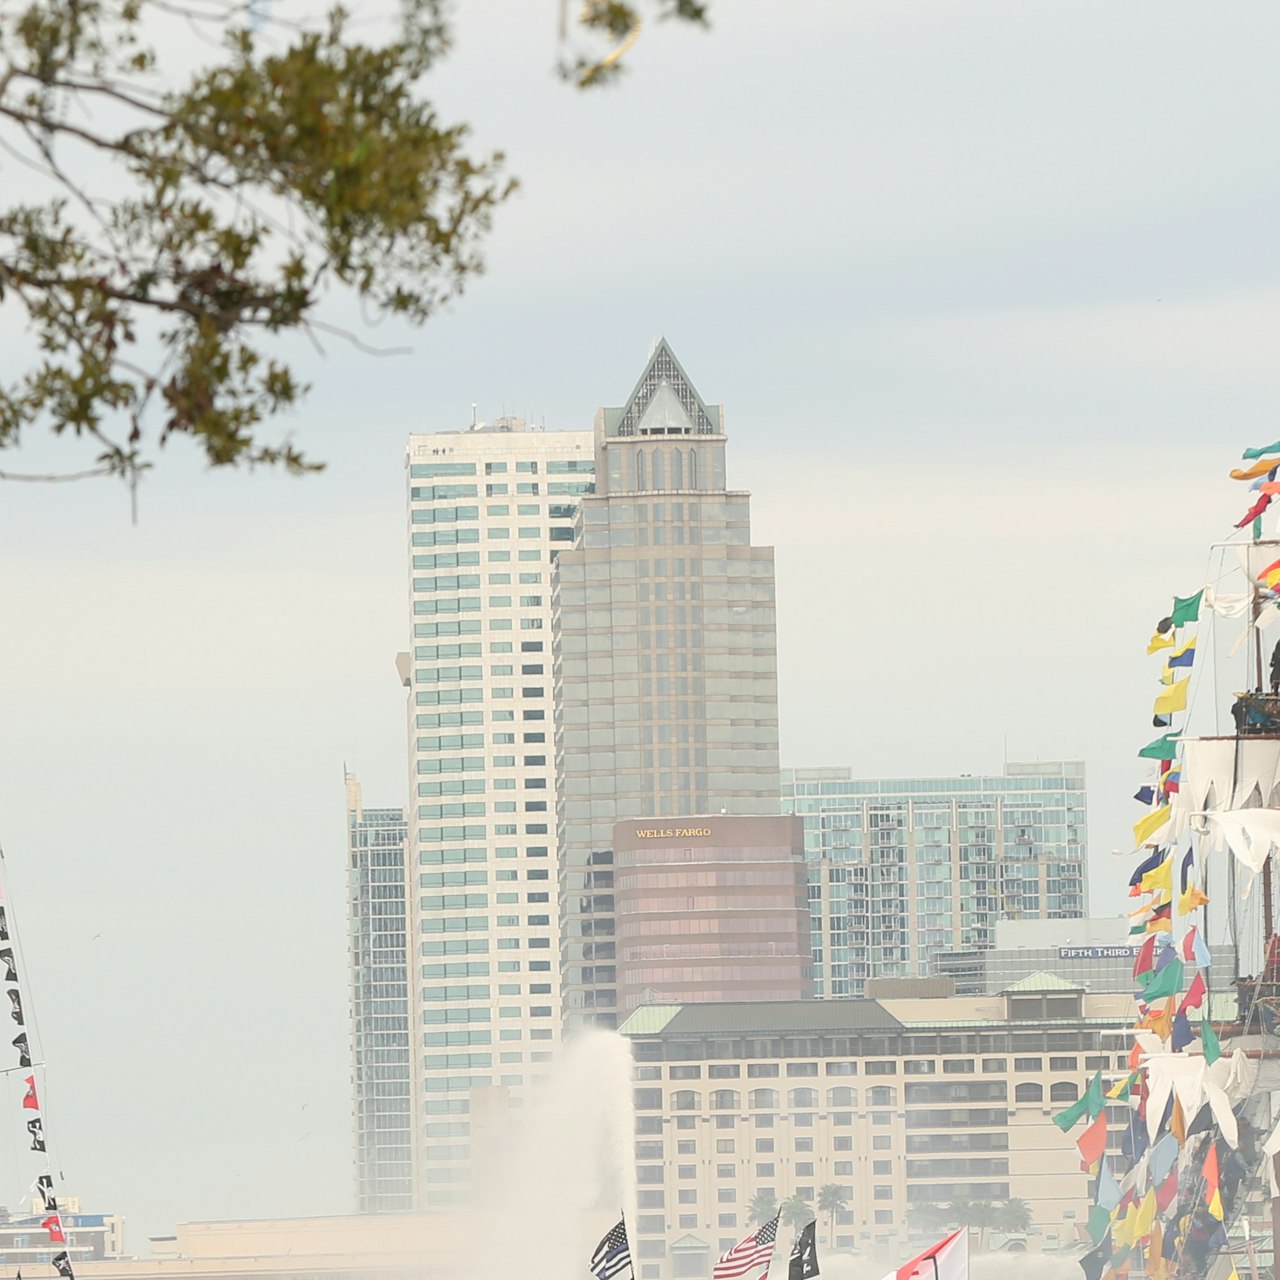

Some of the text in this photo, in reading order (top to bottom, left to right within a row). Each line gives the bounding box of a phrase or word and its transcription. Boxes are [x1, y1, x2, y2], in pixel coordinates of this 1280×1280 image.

[636, 828, 711, 838] WELLS FARGO
[1061, 948, 1092, 957] FIFTH
[1095, 947, 1130, 956] THIRD
